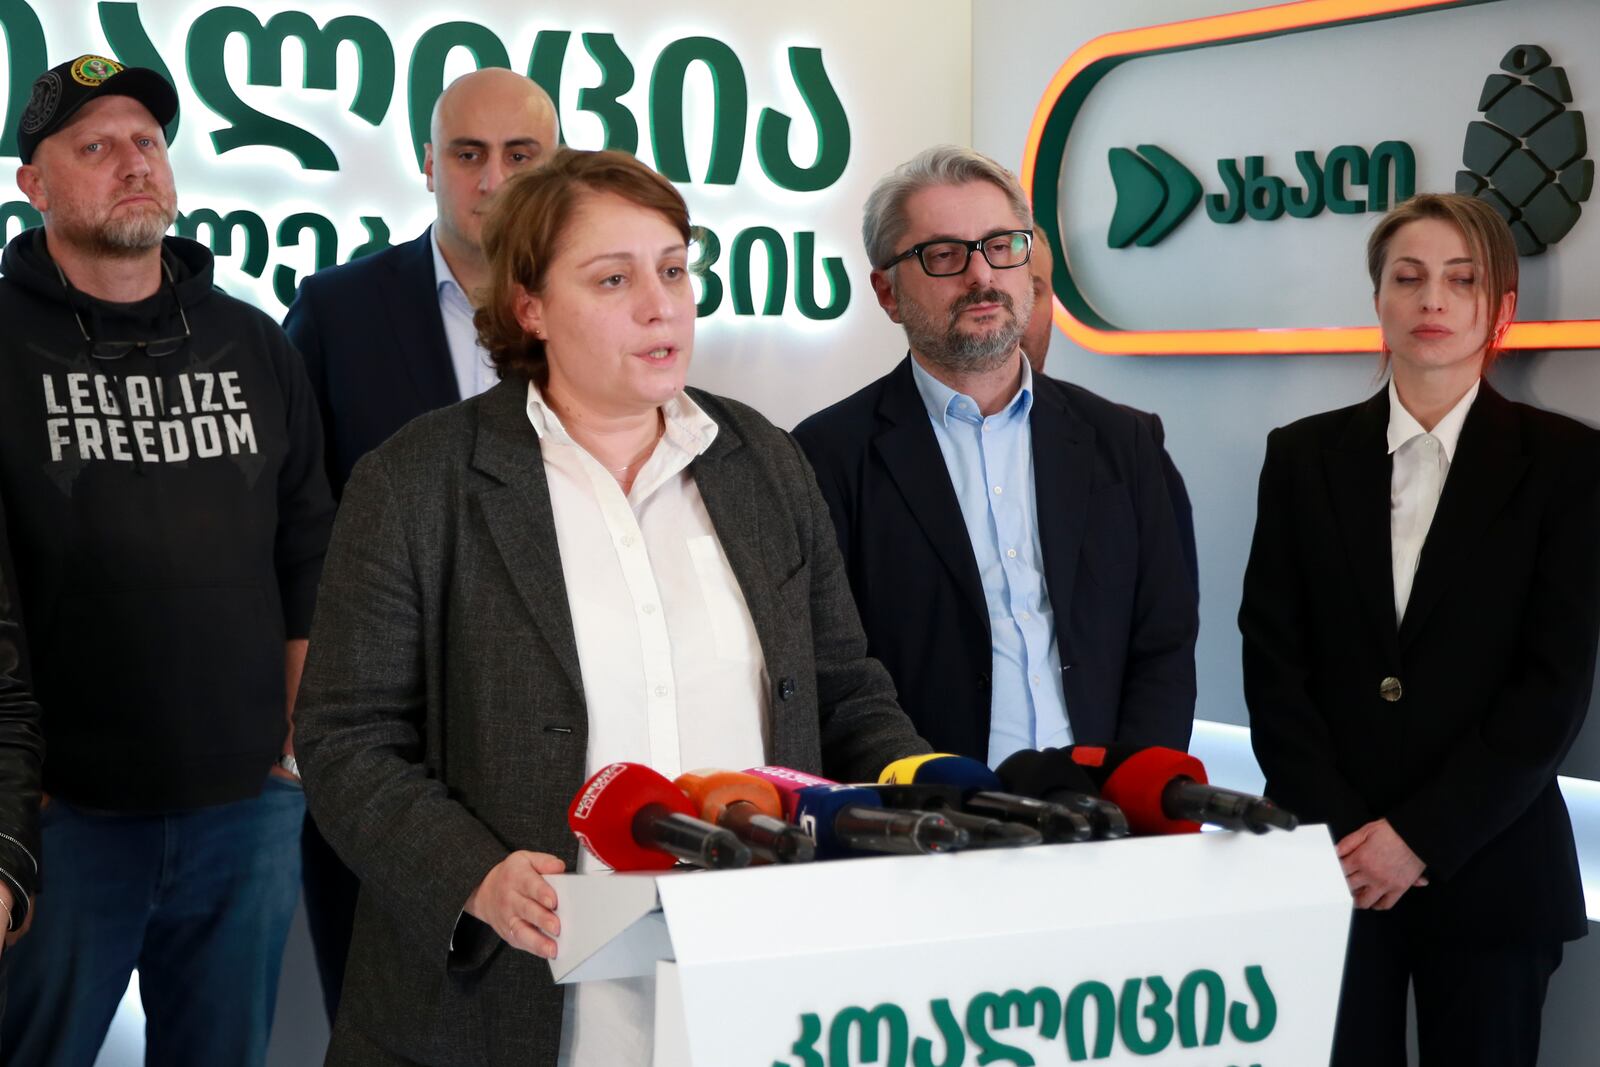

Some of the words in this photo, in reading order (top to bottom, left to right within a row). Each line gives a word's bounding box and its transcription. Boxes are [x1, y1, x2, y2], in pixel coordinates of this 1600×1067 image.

[1205, 140, 1416, 224] ახალი
[43, 371, 247, 416] LEGALIZE
[47, 413, 258, 463] FREEDOM
